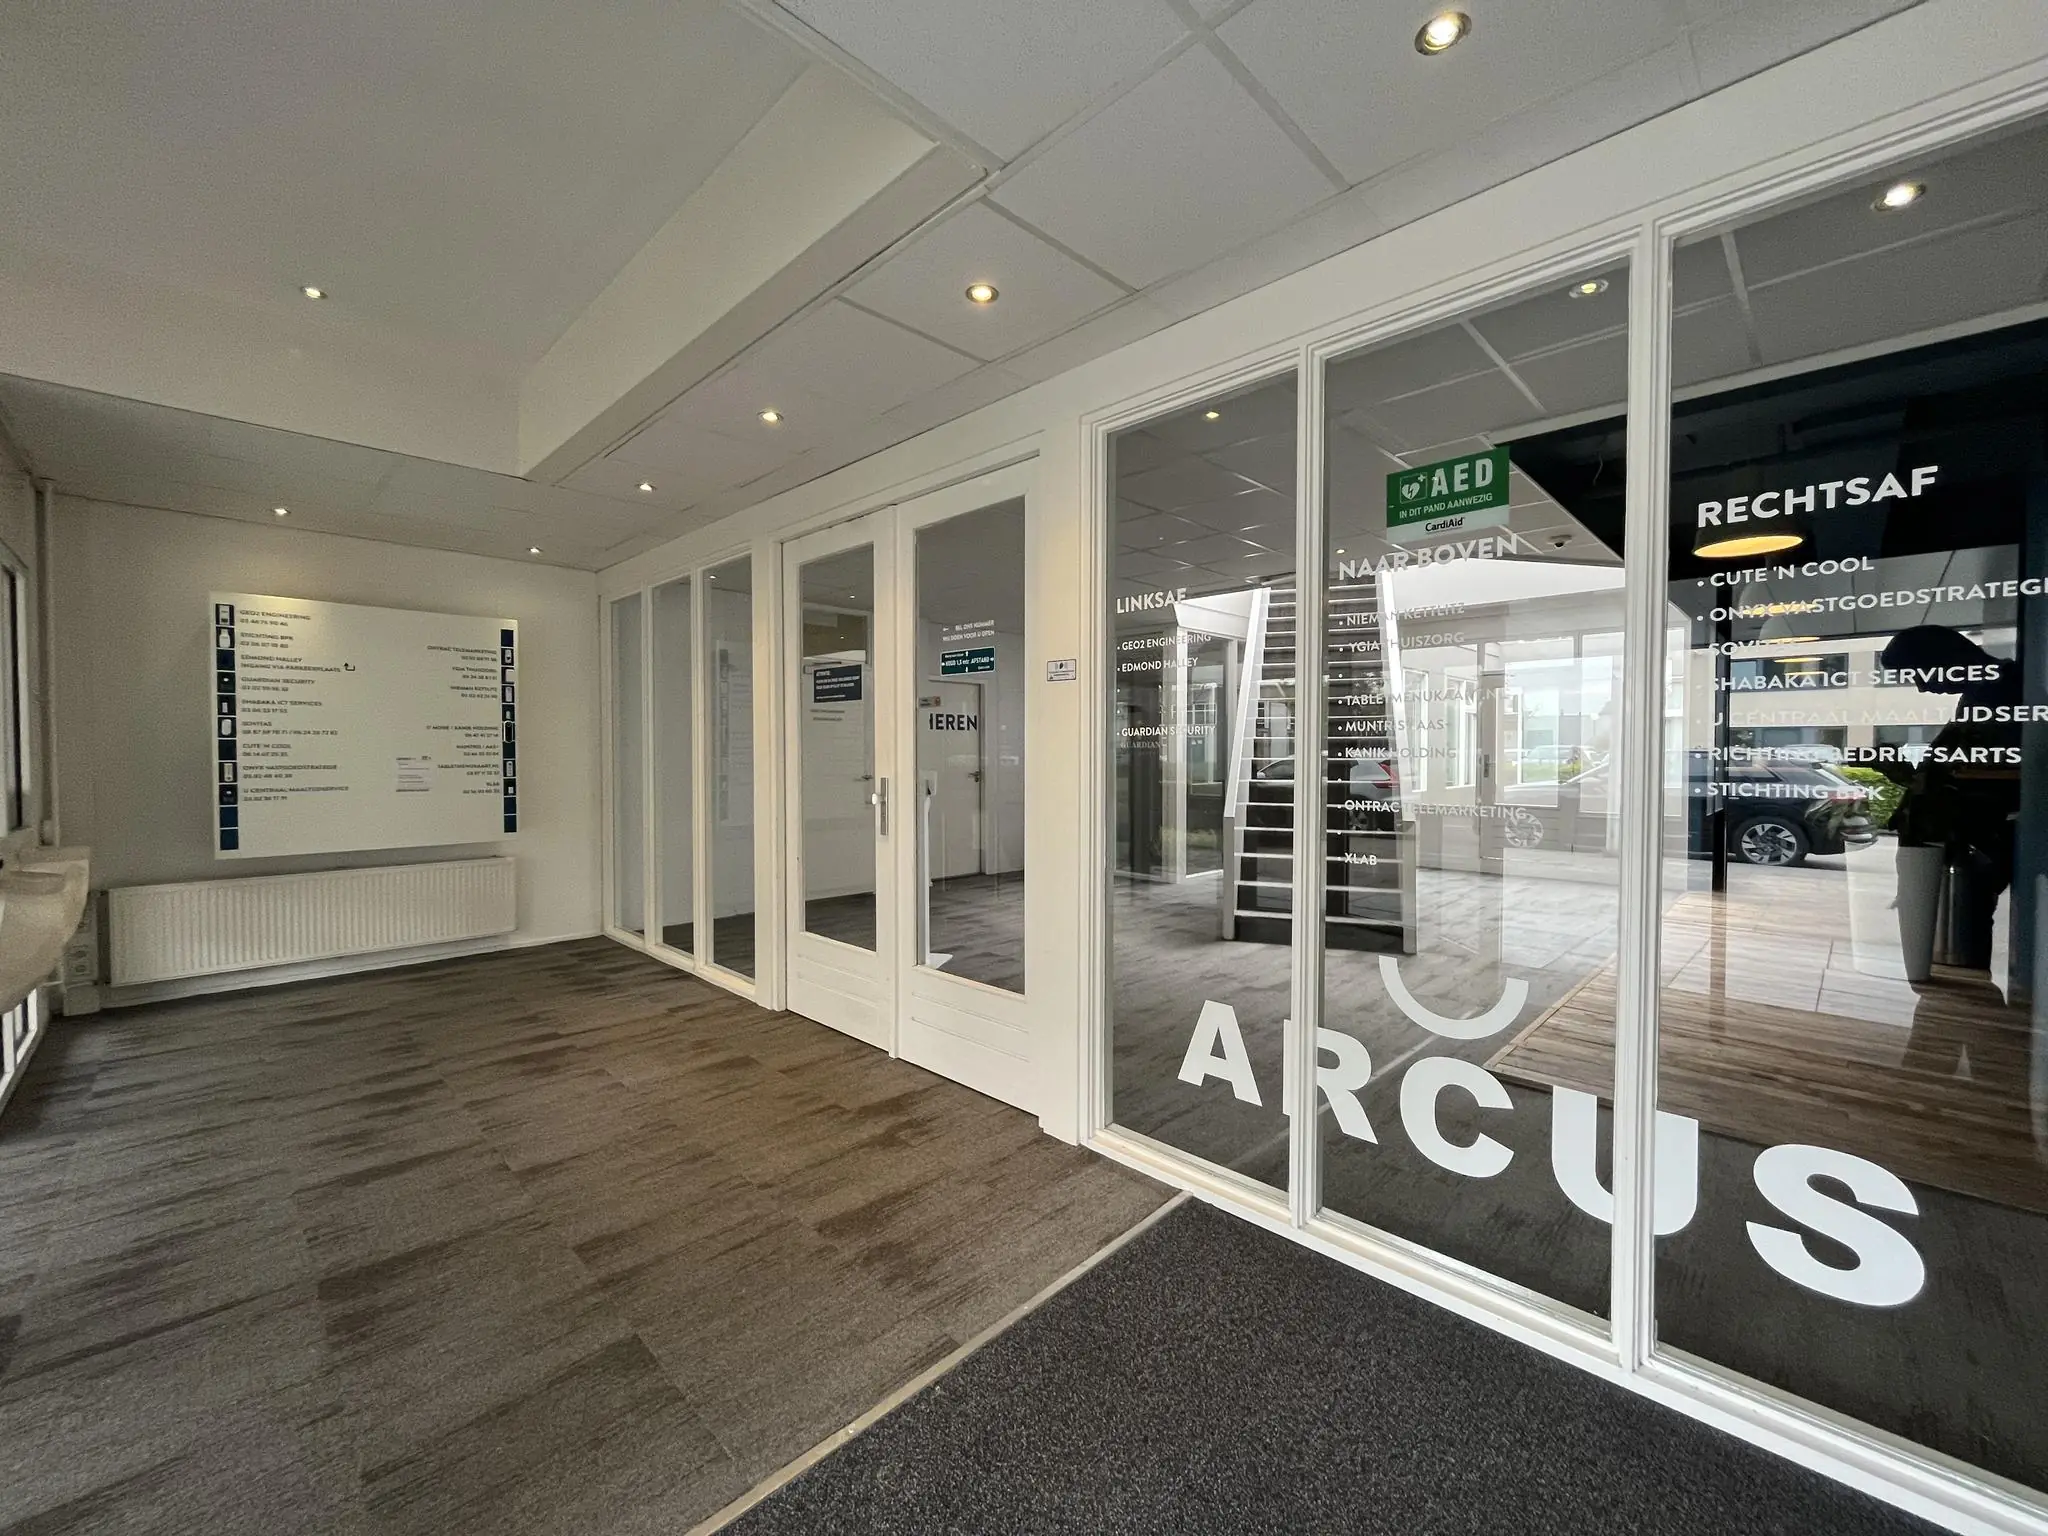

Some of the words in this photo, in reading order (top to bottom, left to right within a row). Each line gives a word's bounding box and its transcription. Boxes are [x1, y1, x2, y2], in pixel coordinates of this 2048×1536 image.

[1431, 458, 1493, 497] AED
[1400, 510, 1408, 518] IN
[1409, 507, 1422, 517] DIT
[1424, 502, 1446, 514] PAND
[1447, 493, 1493, 509] AANWEZIG
[1698, 465, 1938, 527] RECHTSAF
[1425, 517, 1464, 532] CardiAid
[1339, 551, 1410, 580] NAAR
[1417, 534, 1519, 568] BOVEN
[1710, 567, 1768, 587] CUTE
[1773, 564, 1795, 580] 'N
[1801, 556, 1875, 577] COOL
[1116, 588, 1187, 614] LINKSAF
[1347, 607, 1399, 626] NIEMN
[1710, 603, 1774, 622] ONYX
[1122, 639, 1145, 651] GEO2
[1147, 633, 1212, 648] ENGINEERING
[1349, 641, 1379, 653] YGIA
[1385, 632, 1465, 649] HUISZORG
[1709, 637, 1798, 657] SOVI
[1122, 660, 1162, 672] EDMOND
[1163, 657, 1199, 669] HALLEY
[1713, 673, 1816, 691] SHABAKA
[1868, 665, 2001, 687] SERVICES
[1121, 726, 1168, 737] GUARDIAN
[1170, 725, 1216, 735] SURITY
[1345, 747, 1386, 759] KANIK
[1708, 782, 1830, 800] STICHTING
[1344, 800, 1400, 813] ONTRAC
[1345, 852, 1378, 866] XLAB
[1178, 999, 1926, 1306] ARCUS
